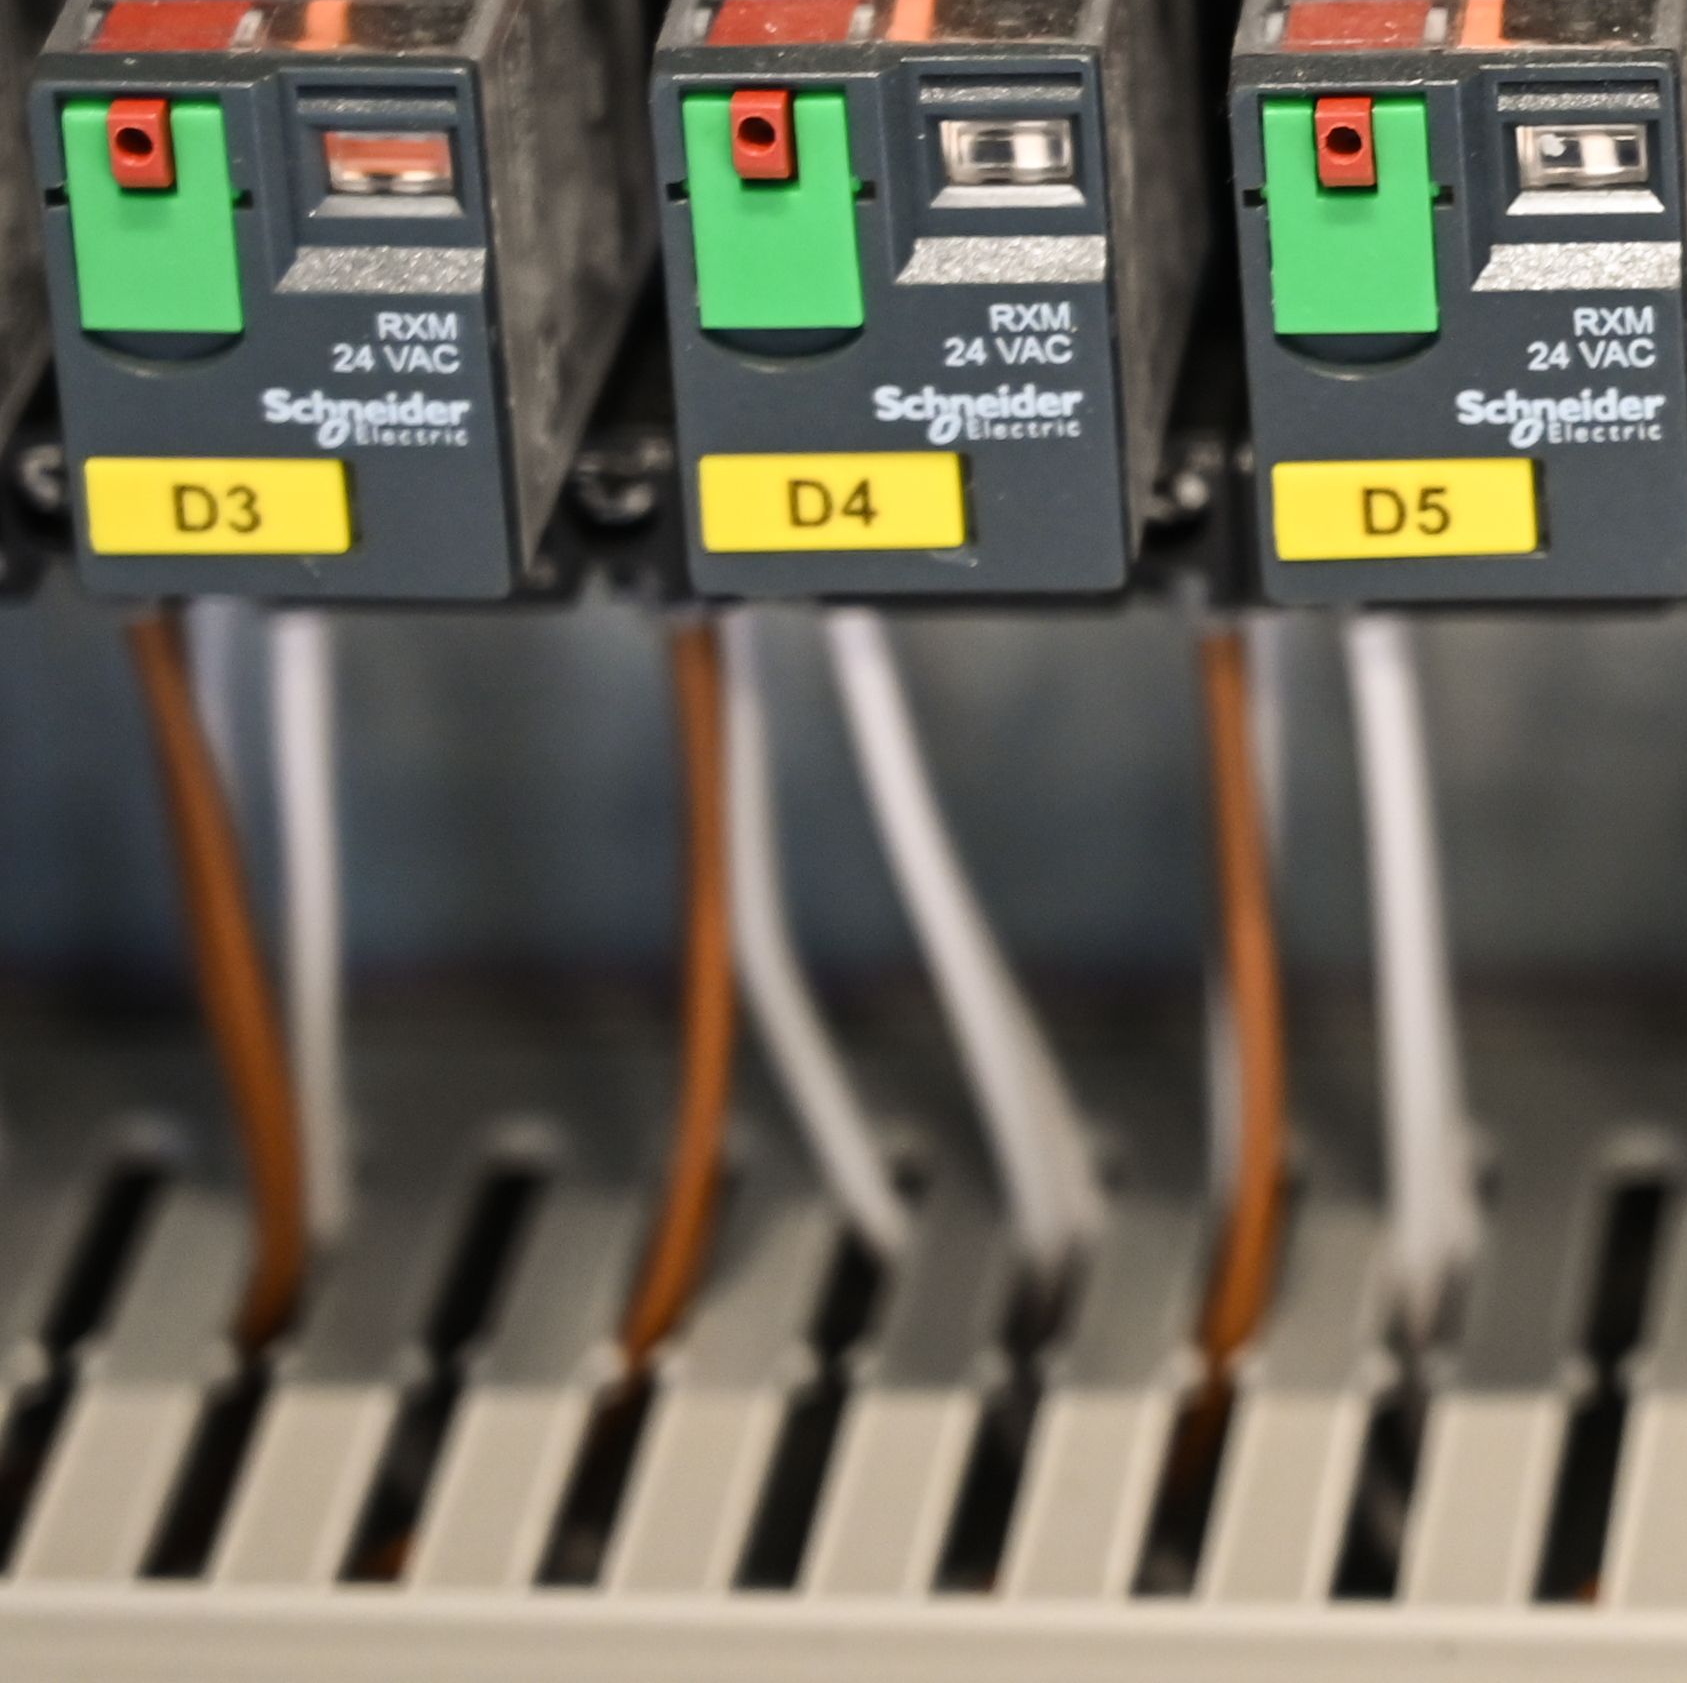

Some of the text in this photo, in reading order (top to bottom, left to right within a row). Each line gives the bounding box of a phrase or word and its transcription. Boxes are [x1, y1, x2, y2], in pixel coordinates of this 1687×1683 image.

[377, 312, 457, 340] RXM
[990, 302, 1070, 337] RXM
[1574, 306, 1654, 336] RXM
[333, 337, 460, 373] 24 VAC
[945, 334, 1073, 366] 24 VAC
[1528, 338, 1656, 371] 24 VAC
[262, 388, 471, 429] Schneider
[873, 384, 1083, 426] Schneider
[1456, 387, 1666, 428] Schneider
[352, 424, 467, 446] Electric
[963, 418, 1080, 440] Electric
[1547, 421, 1662, 443] Electric
[172, 483, 261, 534] D3
[787, 479, 878, 528] D4
[1362, 486, 1451, 536] D5
